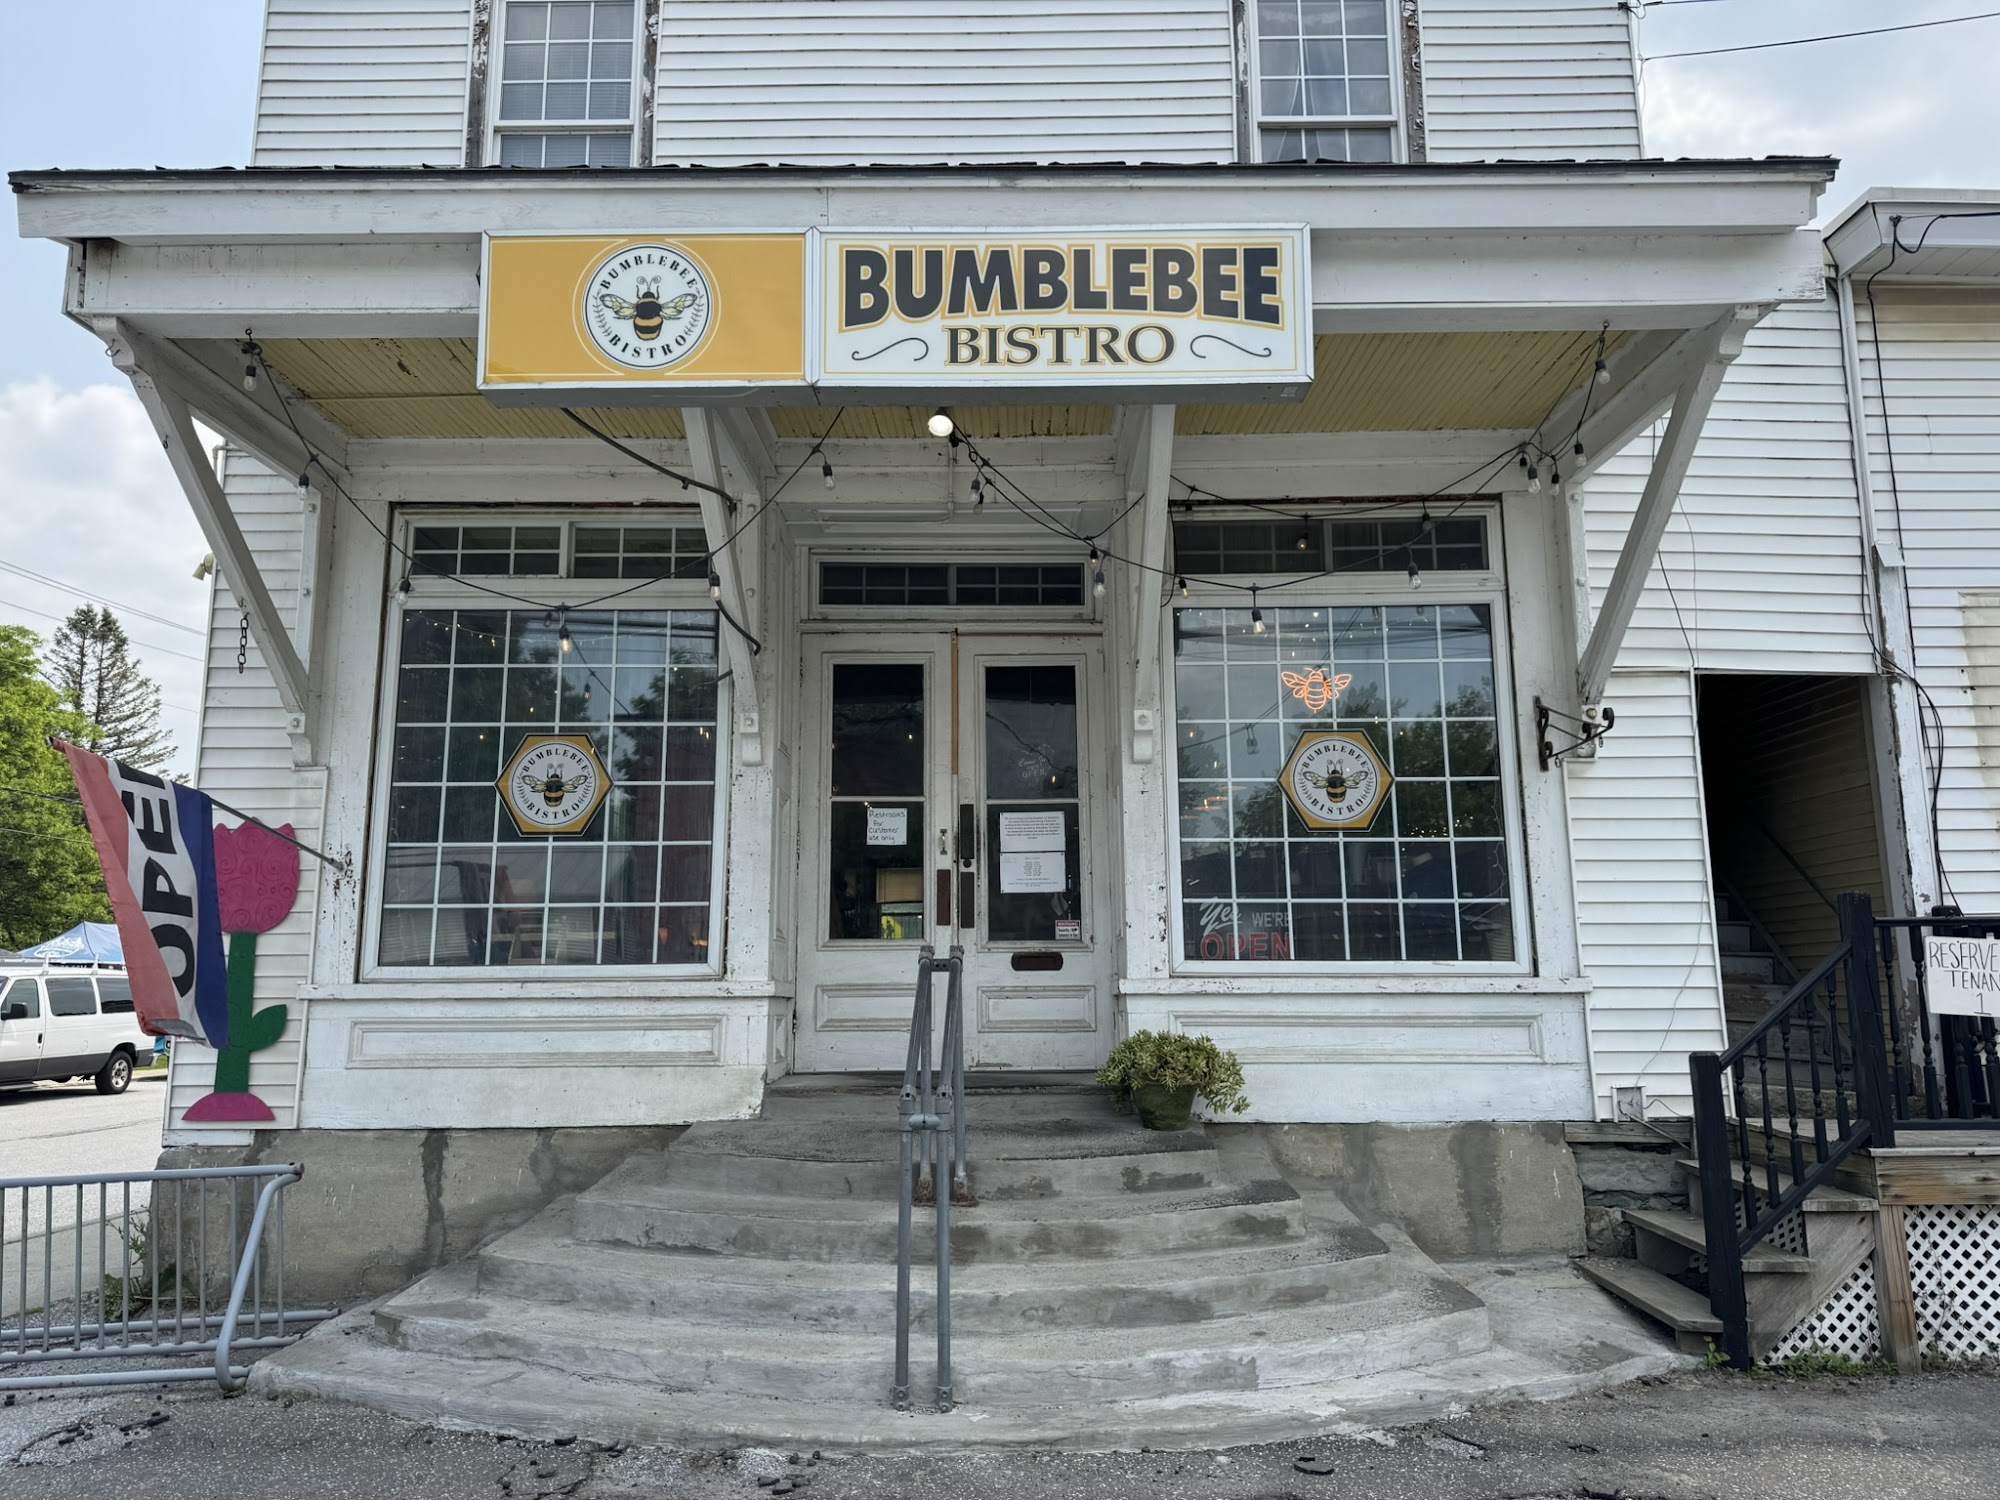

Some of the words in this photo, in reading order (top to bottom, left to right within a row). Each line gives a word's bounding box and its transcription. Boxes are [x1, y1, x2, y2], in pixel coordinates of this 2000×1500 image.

[600, 254, 698, 290] BUMBLEBEE
[842, 245, 1282, 330] BUMBLEBEE
[608, 334, 687, 359] BISTRO
[944, 325, 1176, 367] BISTRO
[522, 748, 590, 773] BUMBLEBEE
[1302, 744, 1369, 769] BUMBLEBEE
[526, 802, 581, 819] BISTRO
[1310, 798, 1364, 815] BISTRO
[1201, 932, 1291, 960] OPEN
[1929, 941, 1999, 972] RESERVE
[1974, 992, 1992, 1016] 1
